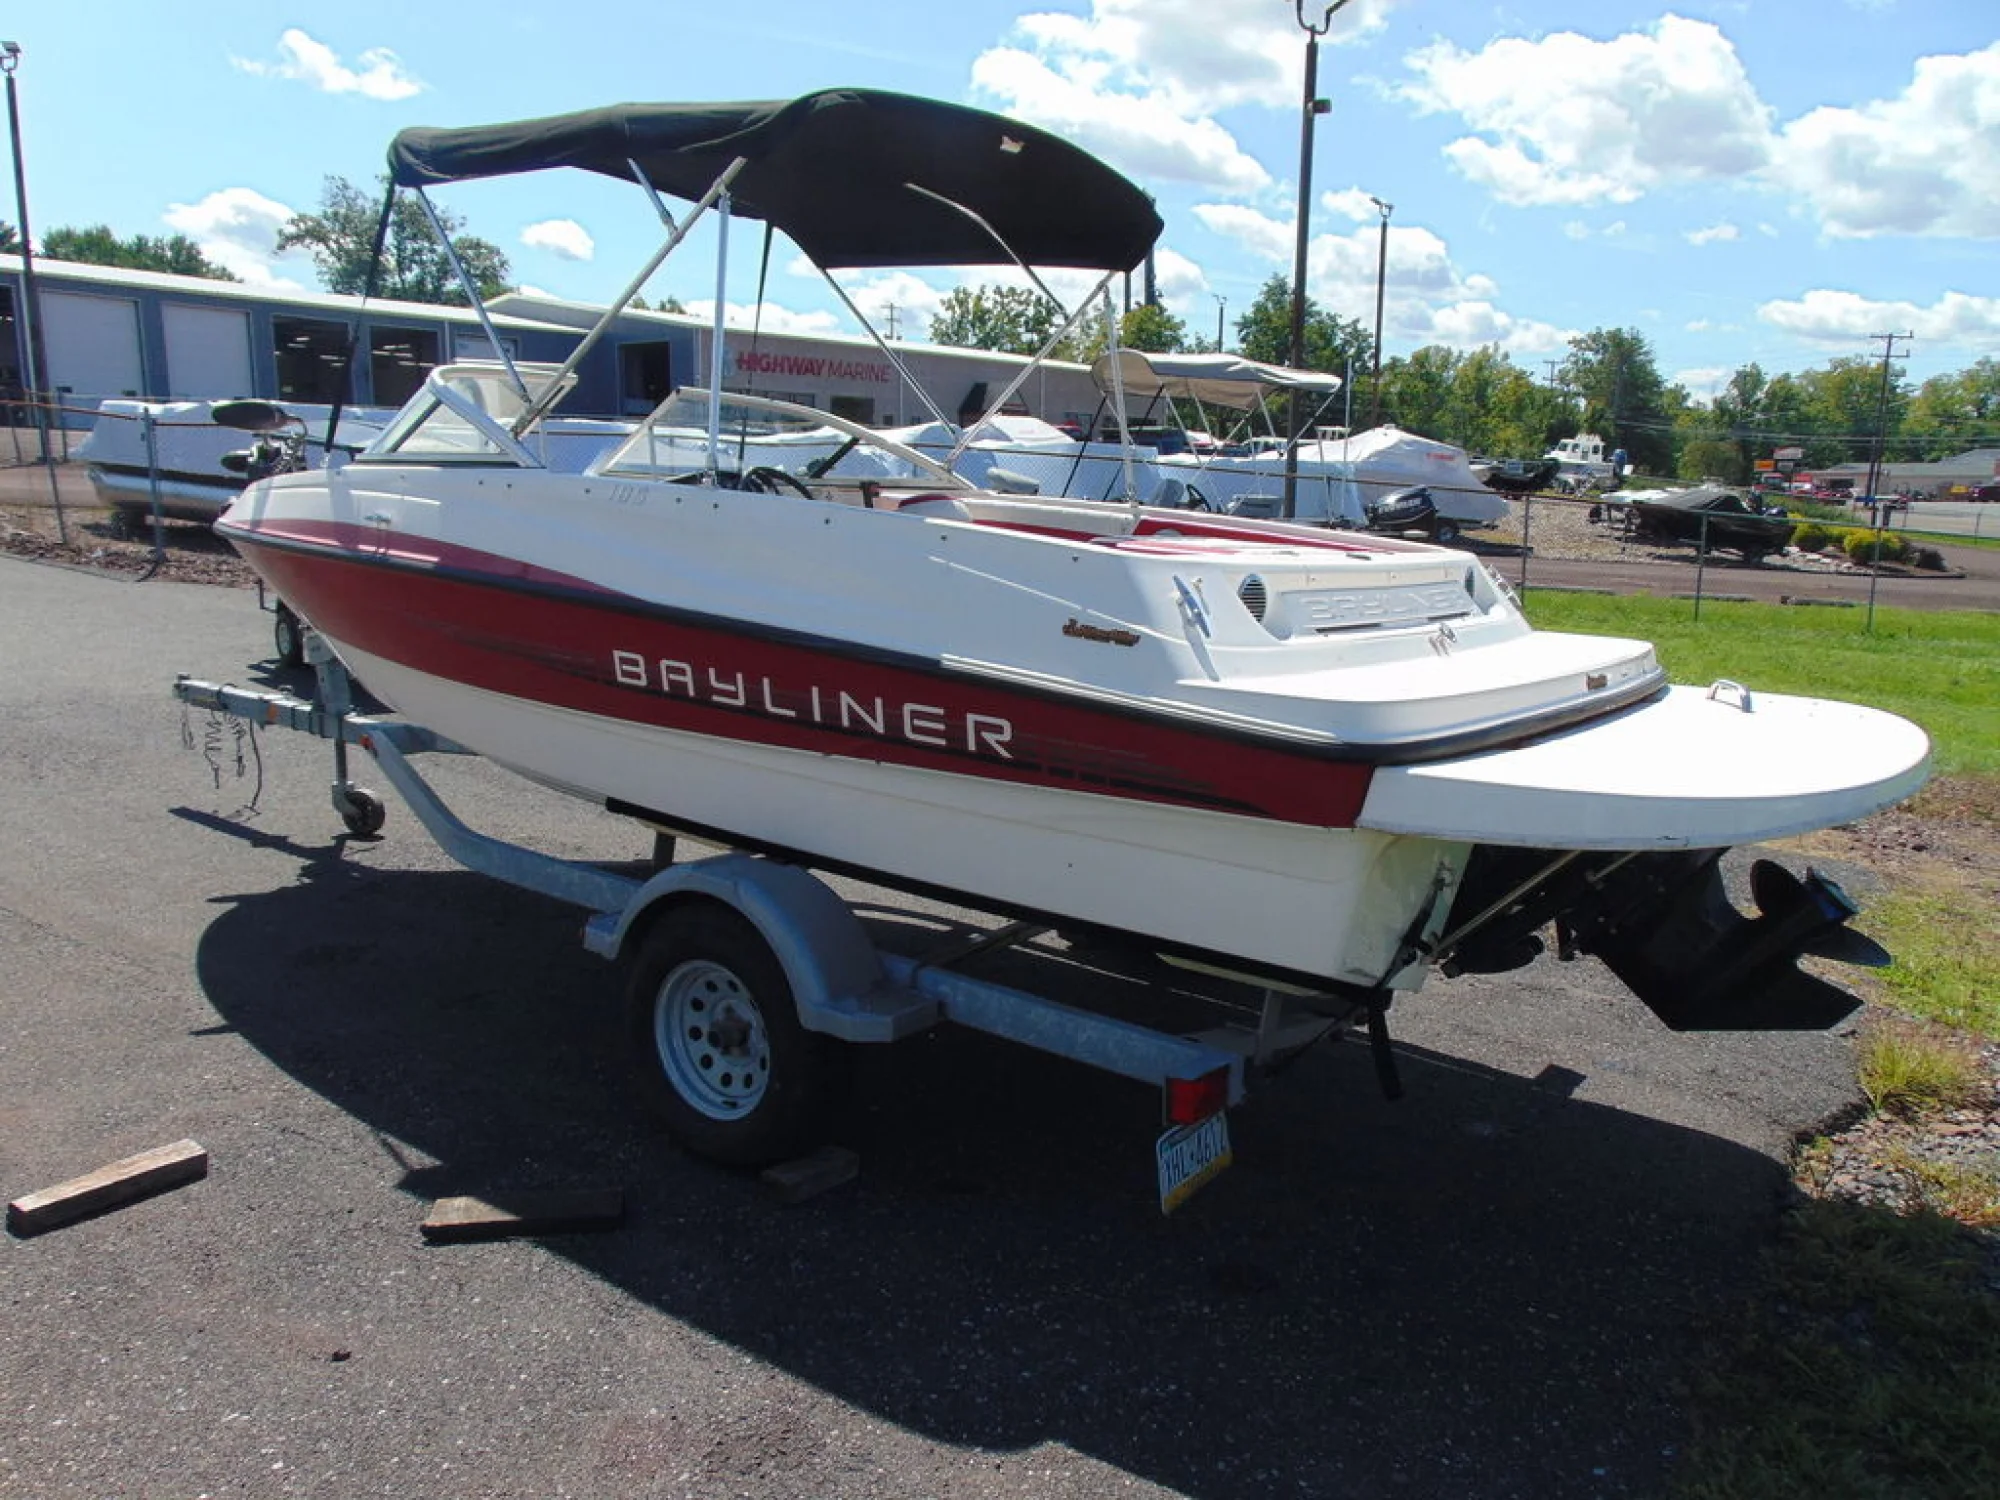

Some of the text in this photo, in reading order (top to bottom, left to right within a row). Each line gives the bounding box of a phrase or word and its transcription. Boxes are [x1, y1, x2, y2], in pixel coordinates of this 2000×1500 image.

[736, 351, 892, 384] HIGHWAY MARINE
[612, 649, 1014, 759] BAYLINER
